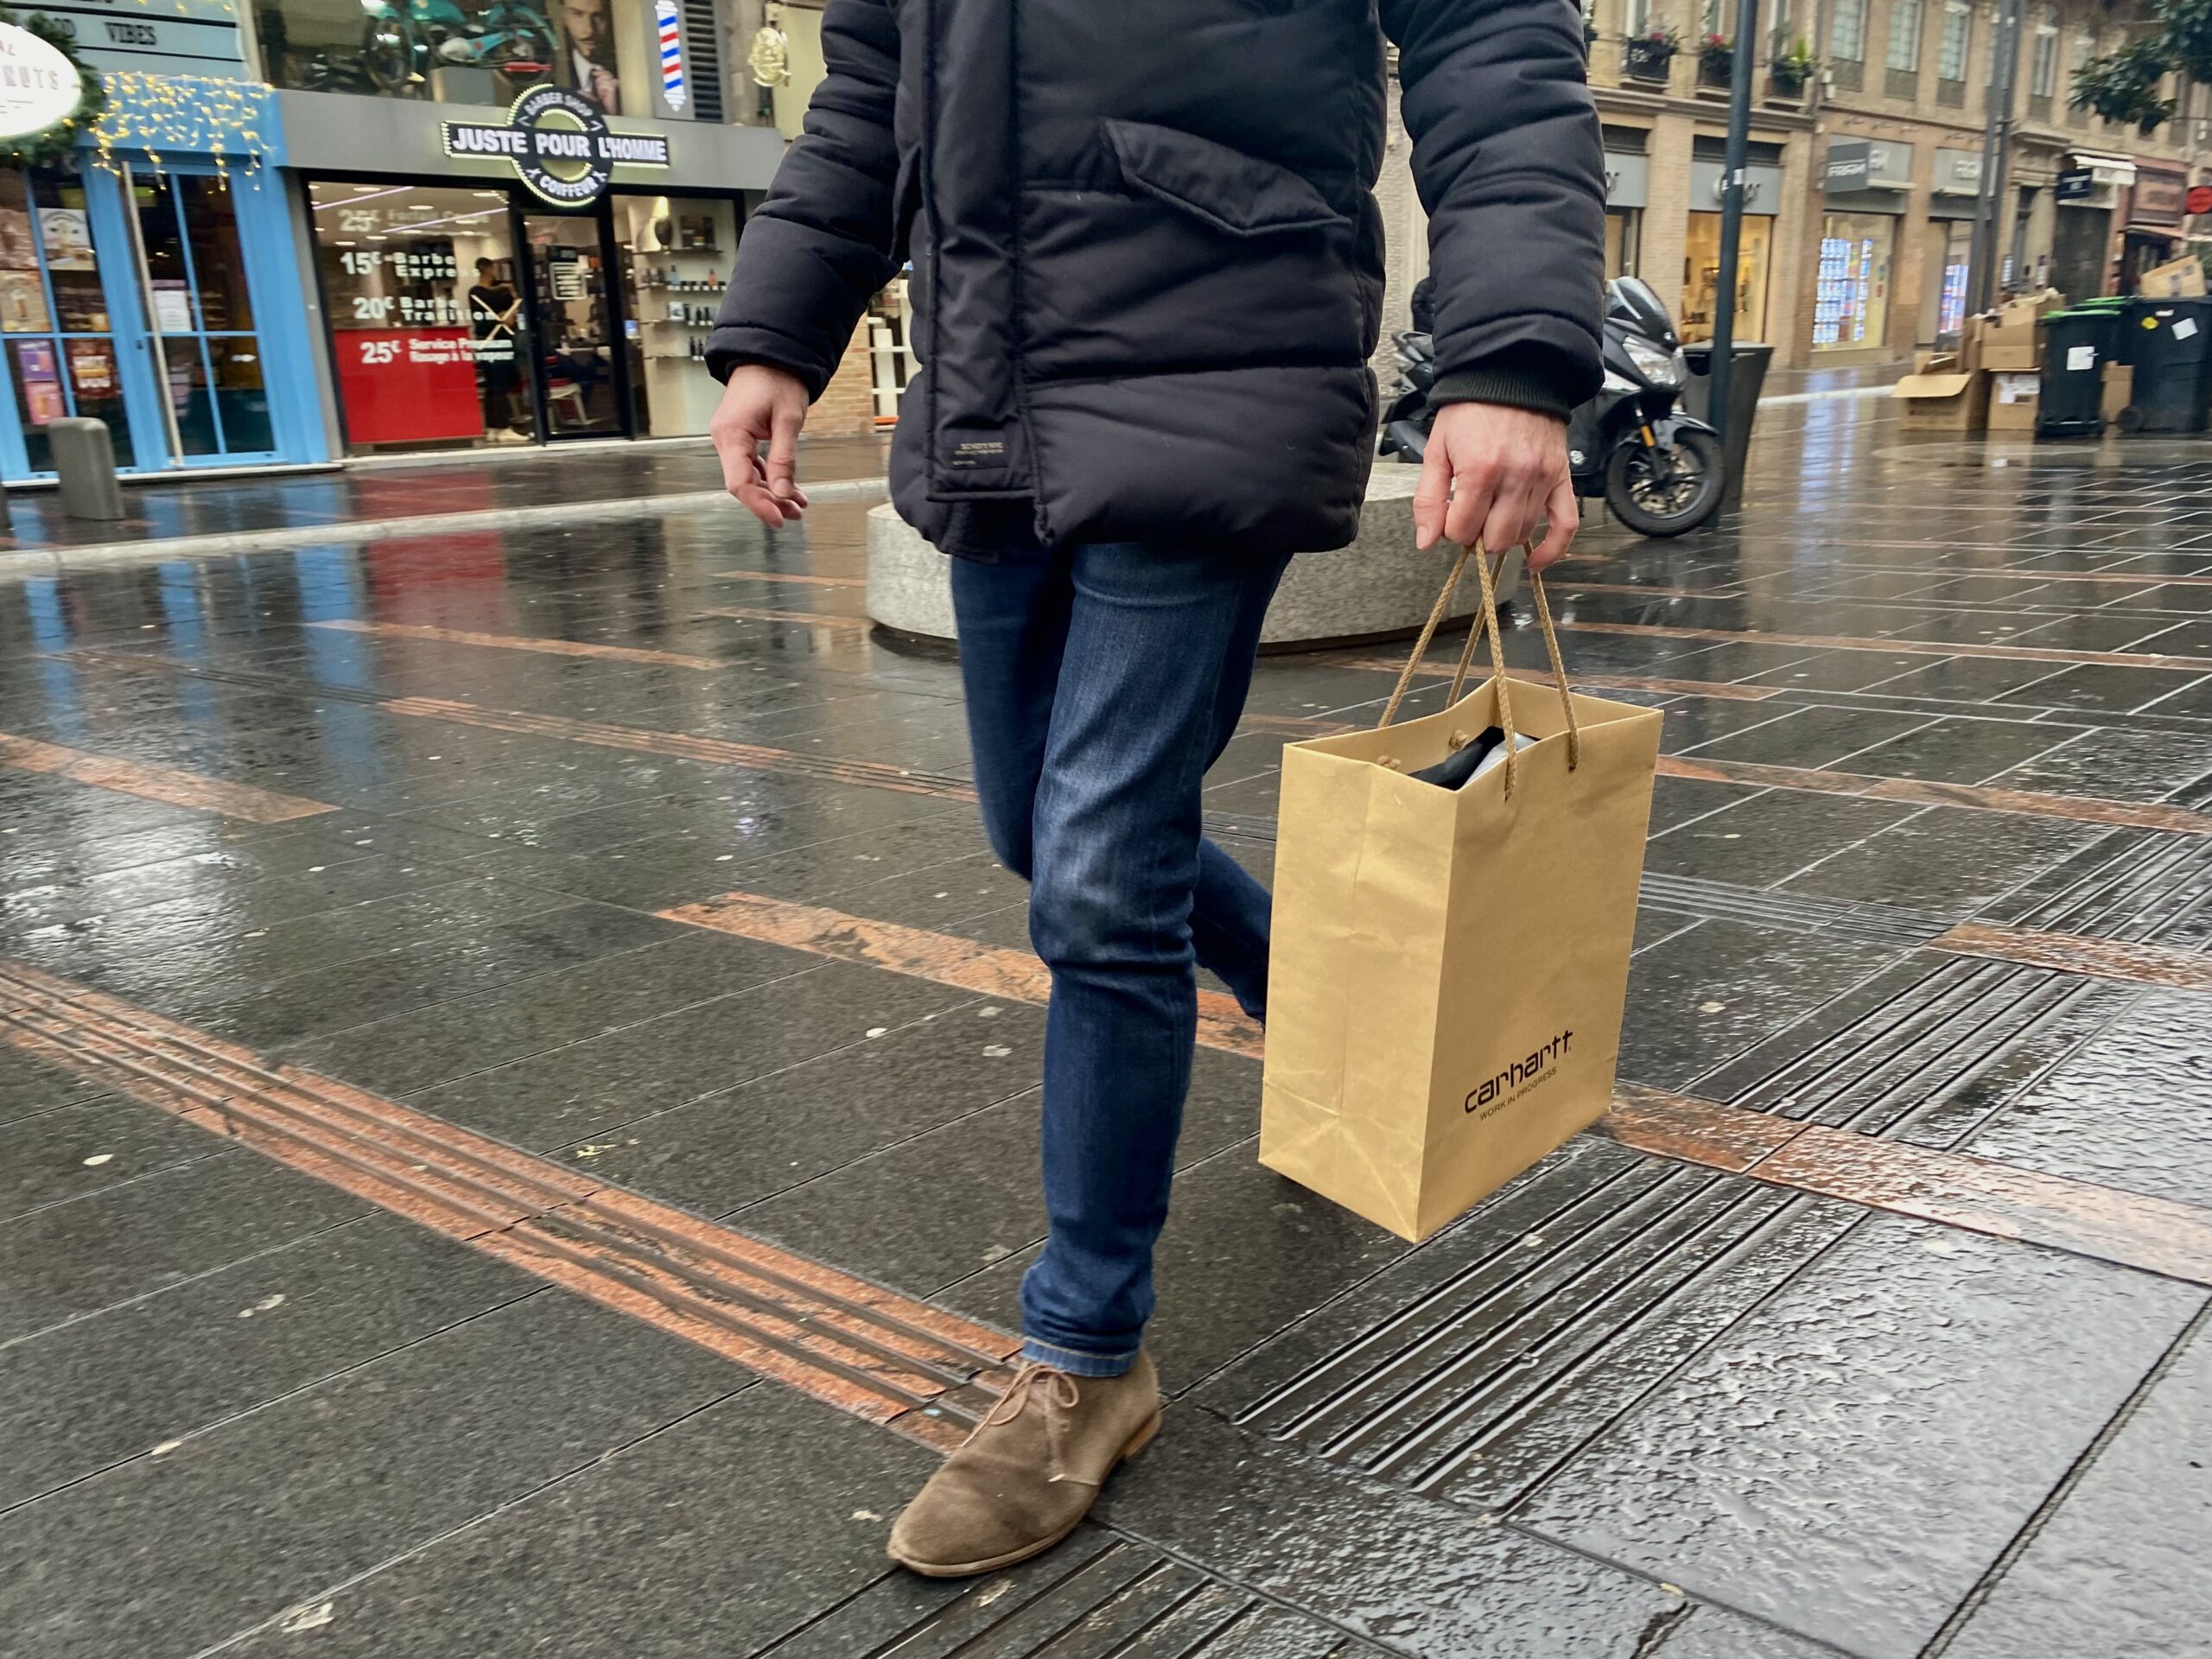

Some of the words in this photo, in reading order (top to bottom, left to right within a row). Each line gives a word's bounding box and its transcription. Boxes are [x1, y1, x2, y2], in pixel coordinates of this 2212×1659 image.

[104, 22, 157, 45] VIBES
[524, 92, 563, 117] BARBER
[563, 94, 594, 118] SHOP
[452, 128, 529, 154] JUSTE
[534, 132, 592, 158] POUR
[598, 137, 667, 162] L'HOMME
[538, 175, 600, 198] COIFFEUR
[340, 251, 382, 275] 15€
[393, 252, 456, 264] Barbe
[353, 296, 395, 320] 20€
[399, 296, 459, 308] Barbe
[359, 340, 403, 364] 25€
[1465, 1029, 1573, 1115] carhartt
[1480, 1101, 1507, 1122] WORK
[1507, 1094, 1516, 1107] IN
[1516, 1066, 1557, 1100] PROGRESS
